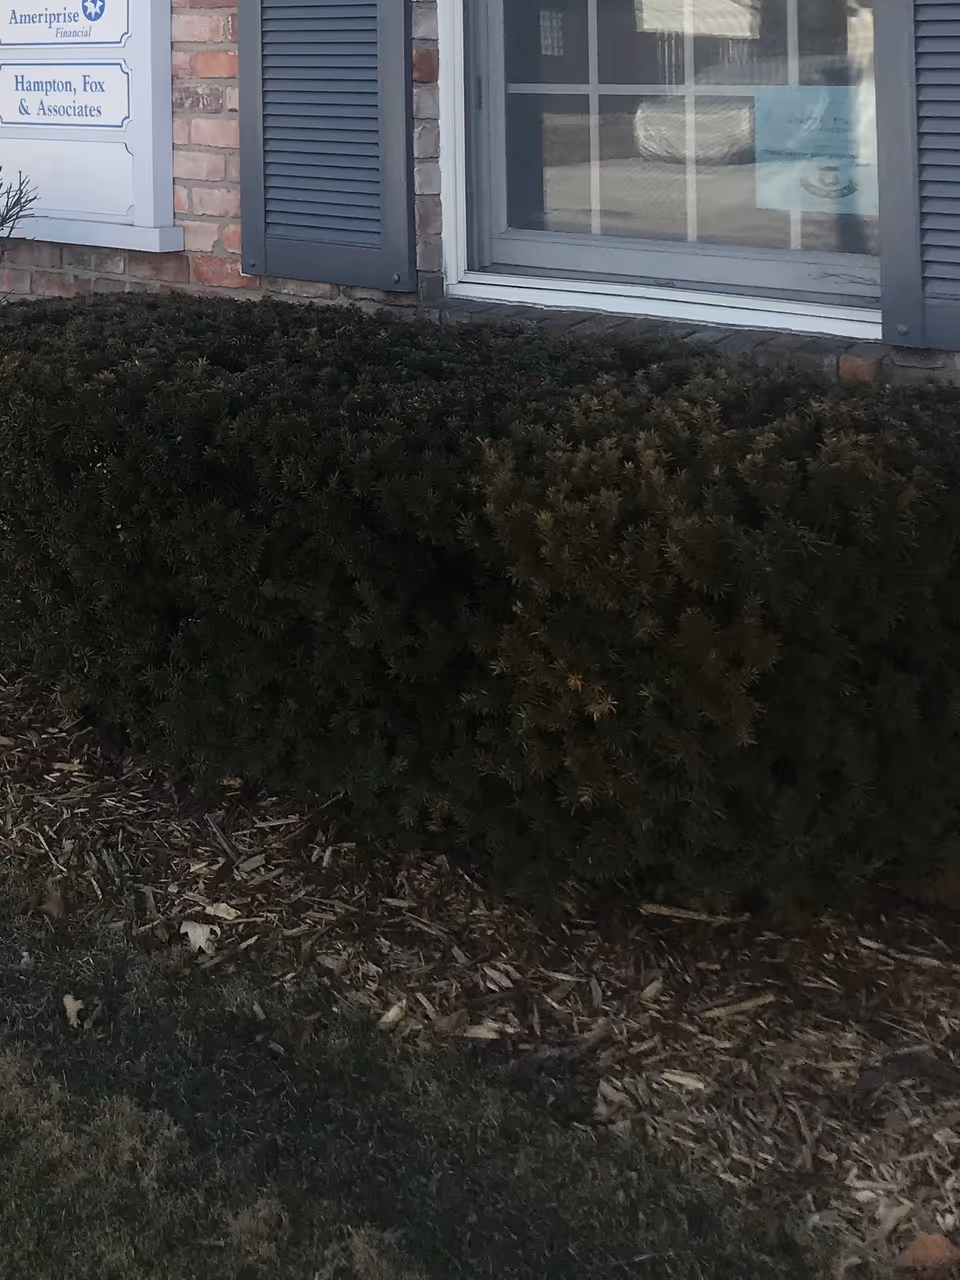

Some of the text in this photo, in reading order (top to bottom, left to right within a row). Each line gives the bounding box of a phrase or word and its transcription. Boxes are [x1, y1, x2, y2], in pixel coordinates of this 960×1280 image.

[9, 7, 79, 29] Ameriprise
[55, 26, 92, 38] Financial
[14, 74, 105, 96] Hampton, Fox
[18, 98, 102, 117] & Associates
